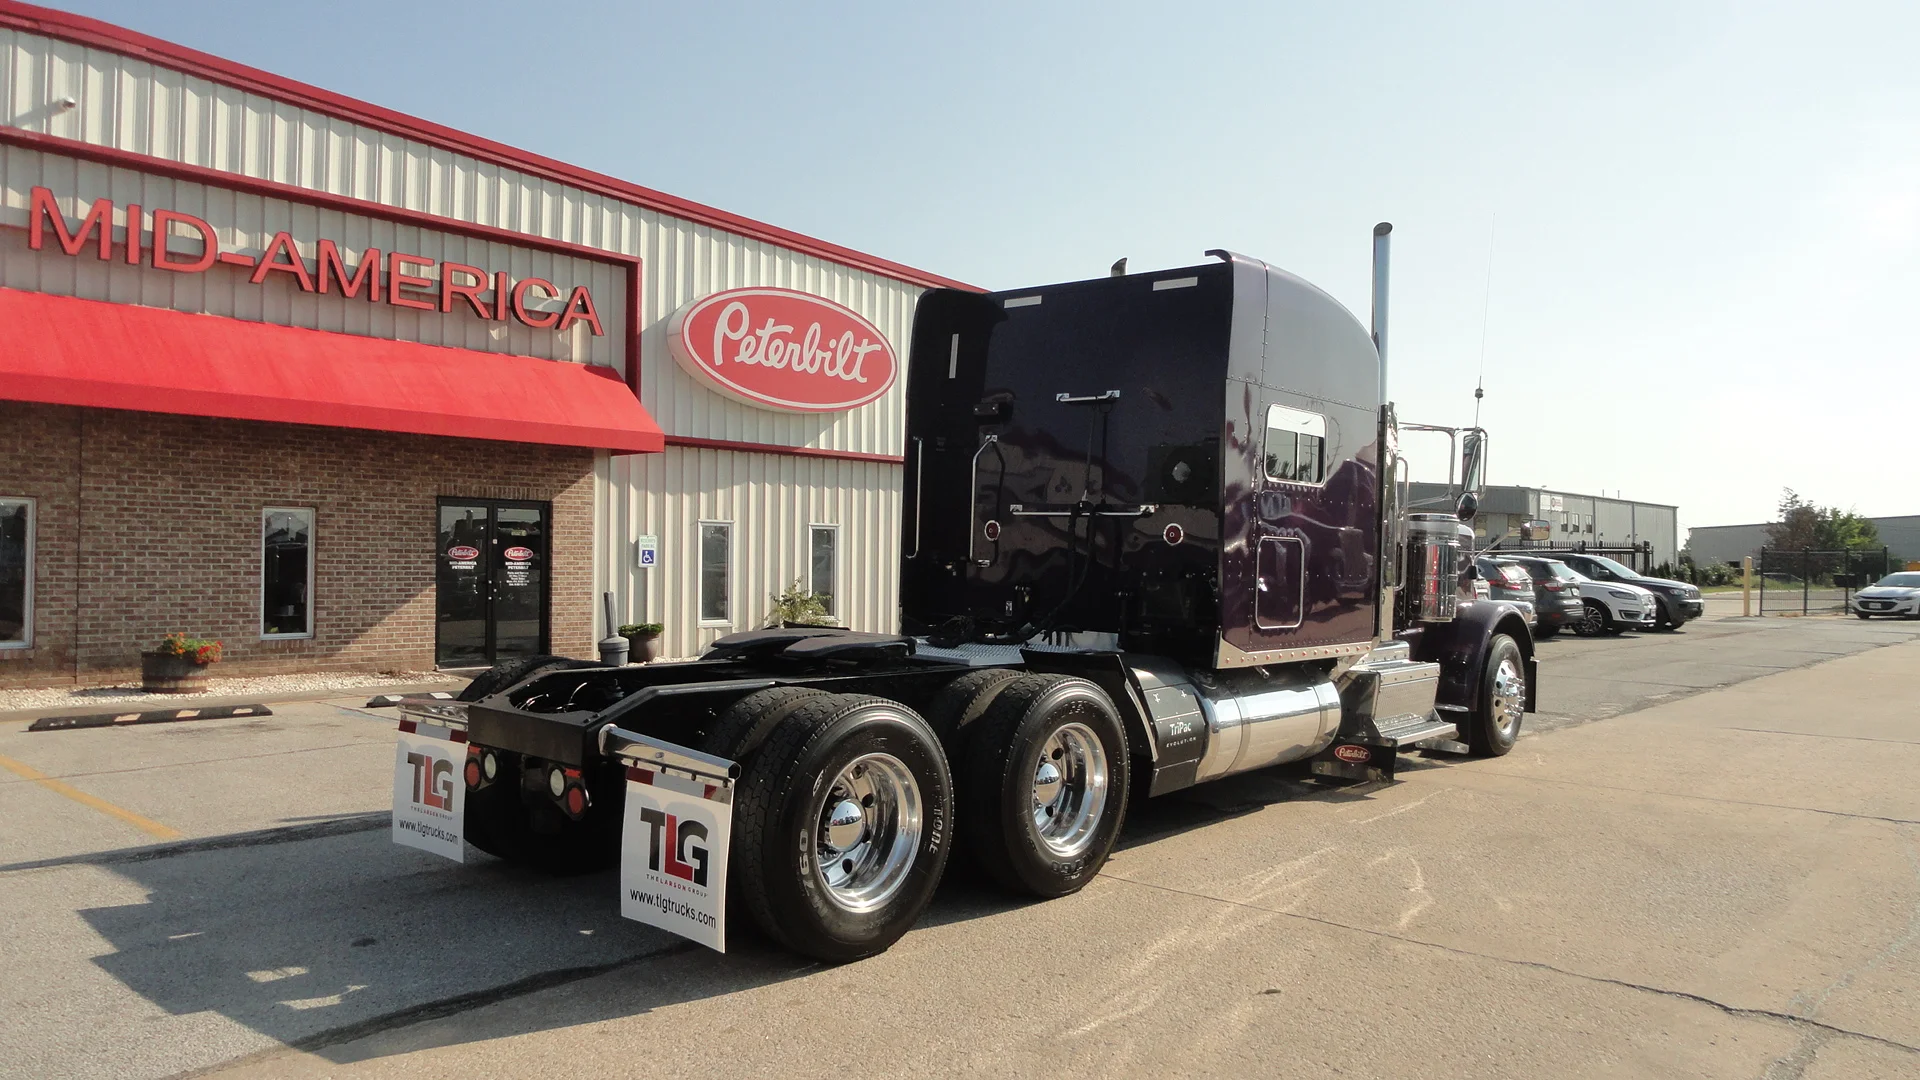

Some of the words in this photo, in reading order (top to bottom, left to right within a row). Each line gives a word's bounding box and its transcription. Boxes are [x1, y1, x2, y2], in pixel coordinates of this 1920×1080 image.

[28, 185, 604, 336] MID-AMERICA
[714, 301, 882, 383] Peterbilt
[1169, 721, 1192, 736] TriPac
[1339, 748, 1368, 759] Peterbilt
[407, 751, 454, 812] TLG
[399, 819, 458, 844] www.tlgtrucks.com
[640, 806, 709, 888] TLG
[646, 873, 659, 882] THE
[660, 878, 686, 892] LARSON
[687, 887, 708, 898] GROUP
[629, 888, 717, 929] www.tlgtrucks.com
